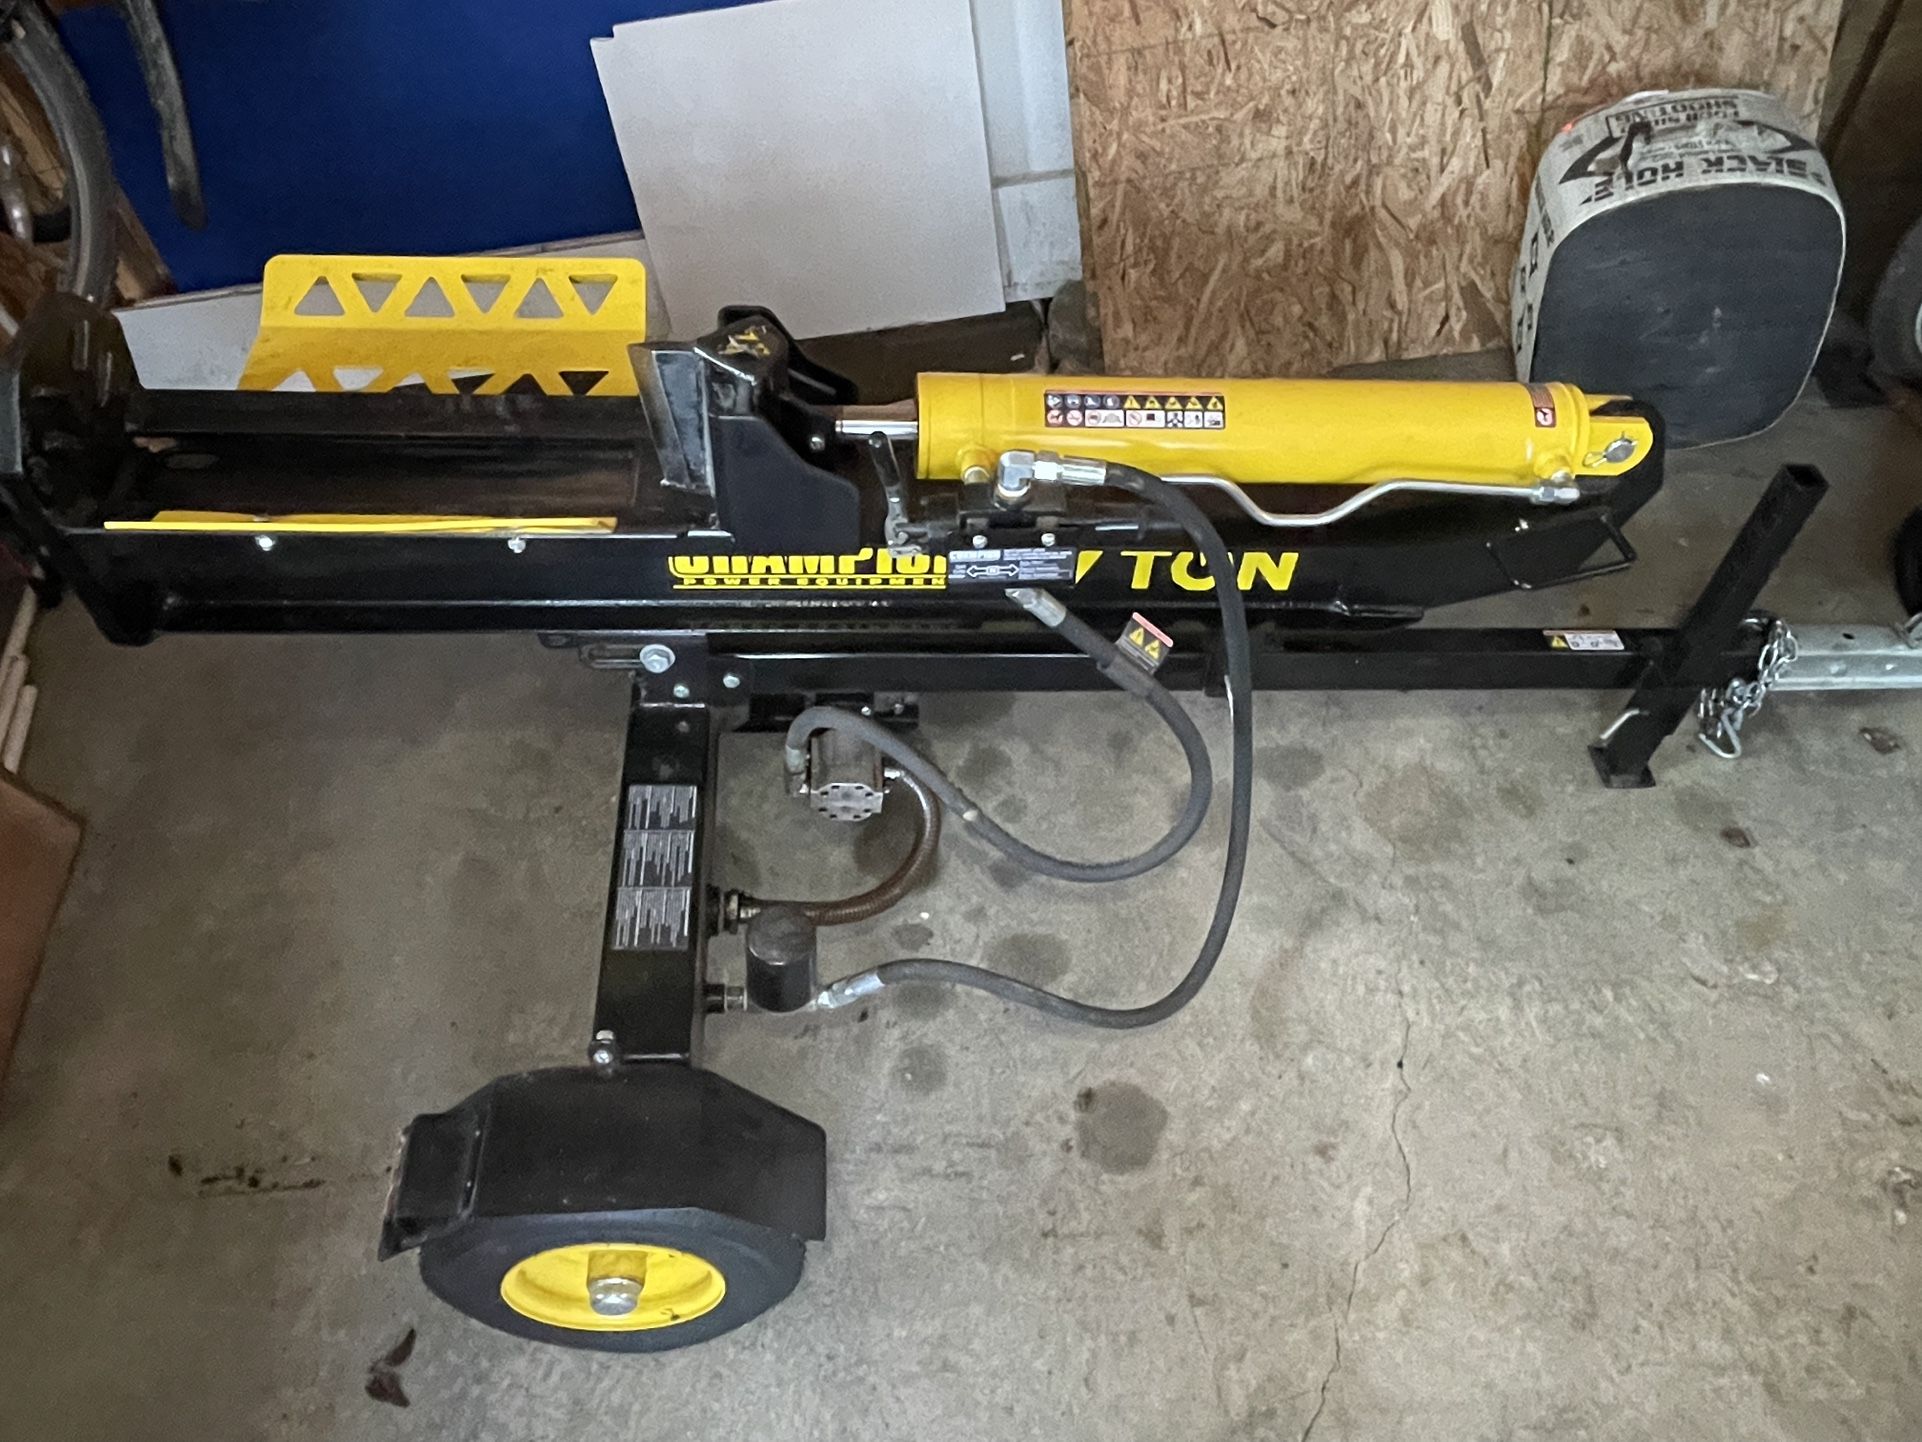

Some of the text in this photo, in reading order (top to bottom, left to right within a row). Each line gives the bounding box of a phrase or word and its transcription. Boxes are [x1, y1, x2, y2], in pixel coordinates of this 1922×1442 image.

[1701, 154, 1808, 179] BLACK
[683, 577, 780, 586] POWER
[1120, 551, 1300, 591] TON
